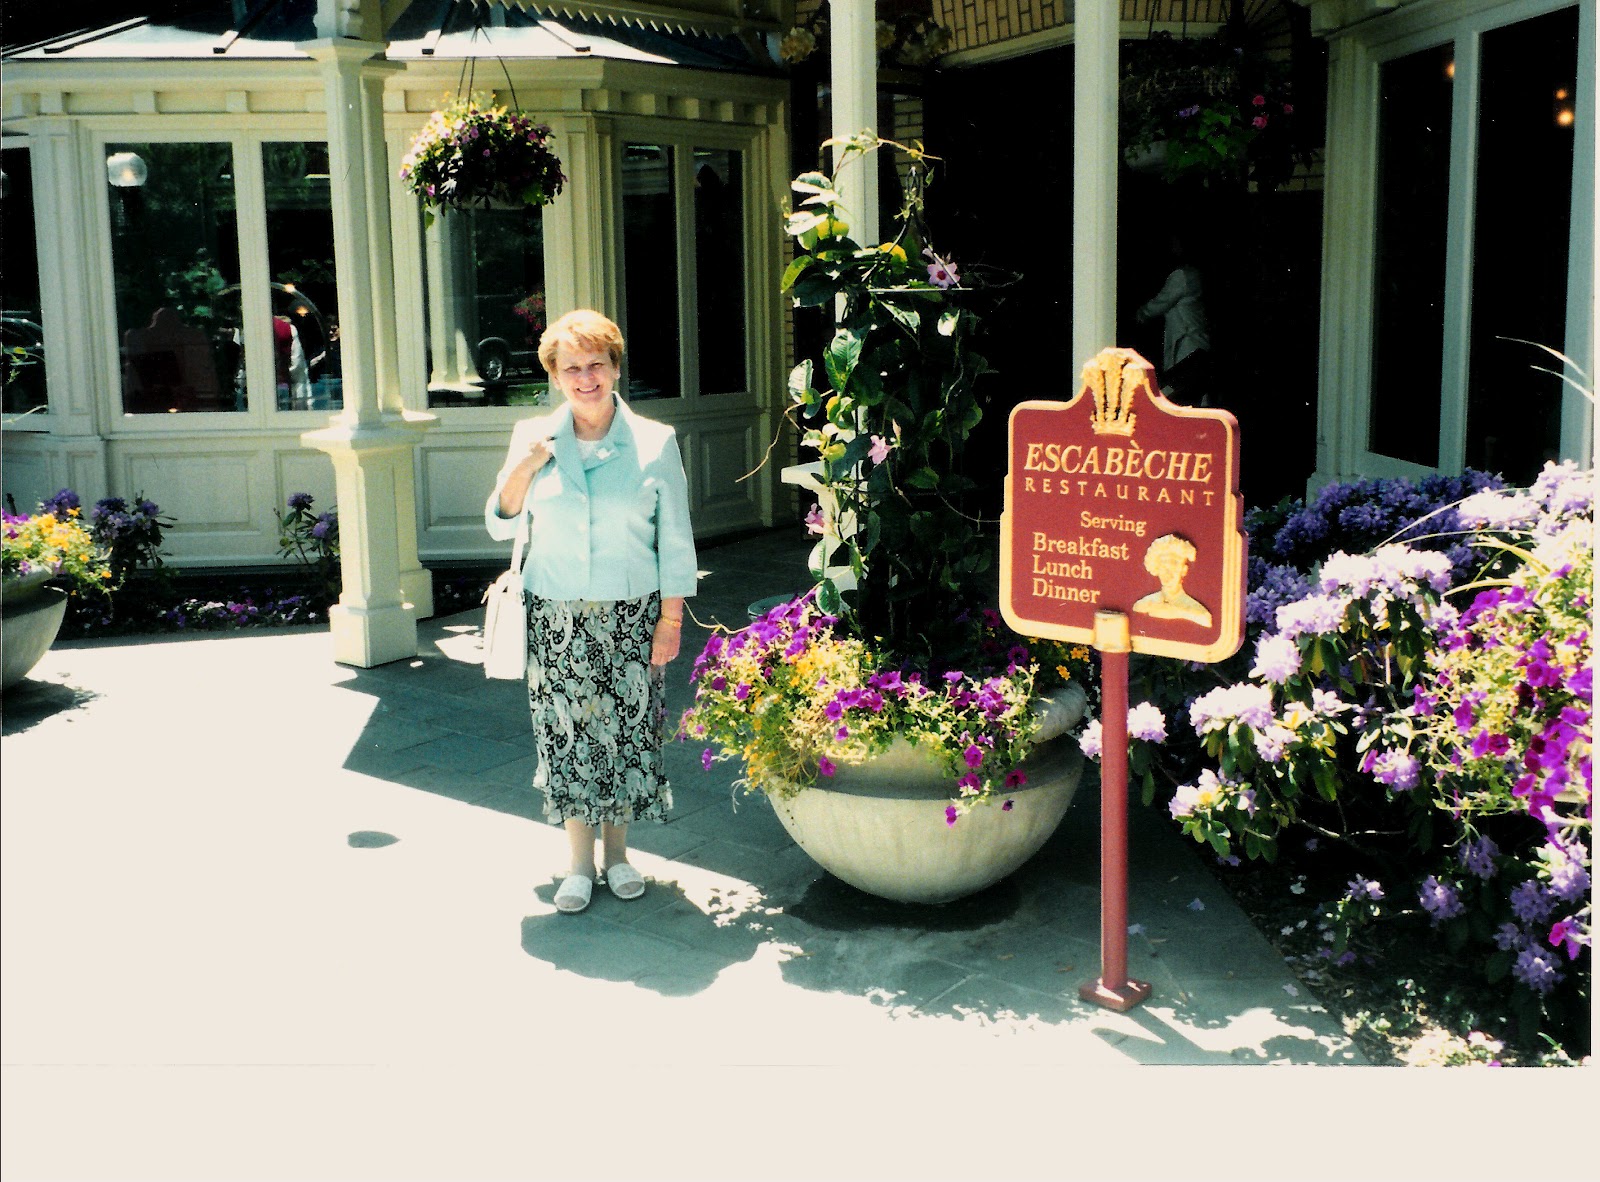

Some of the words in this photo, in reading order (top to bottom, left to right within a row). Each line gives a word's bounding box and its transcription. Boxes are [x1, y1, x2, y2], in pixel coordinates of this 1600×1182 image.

[1024, 441, 1212, 483] ESCABÈCHE
[1025, 477, 1215, 506] RESTAURANT
[1080, 511, 1147, 536] Serving
[1033, 532, 1129, 560] Breakfast
[1033, 555, 1093, 579] Lunch
[1033, 578, 1100, 603] Dinner
